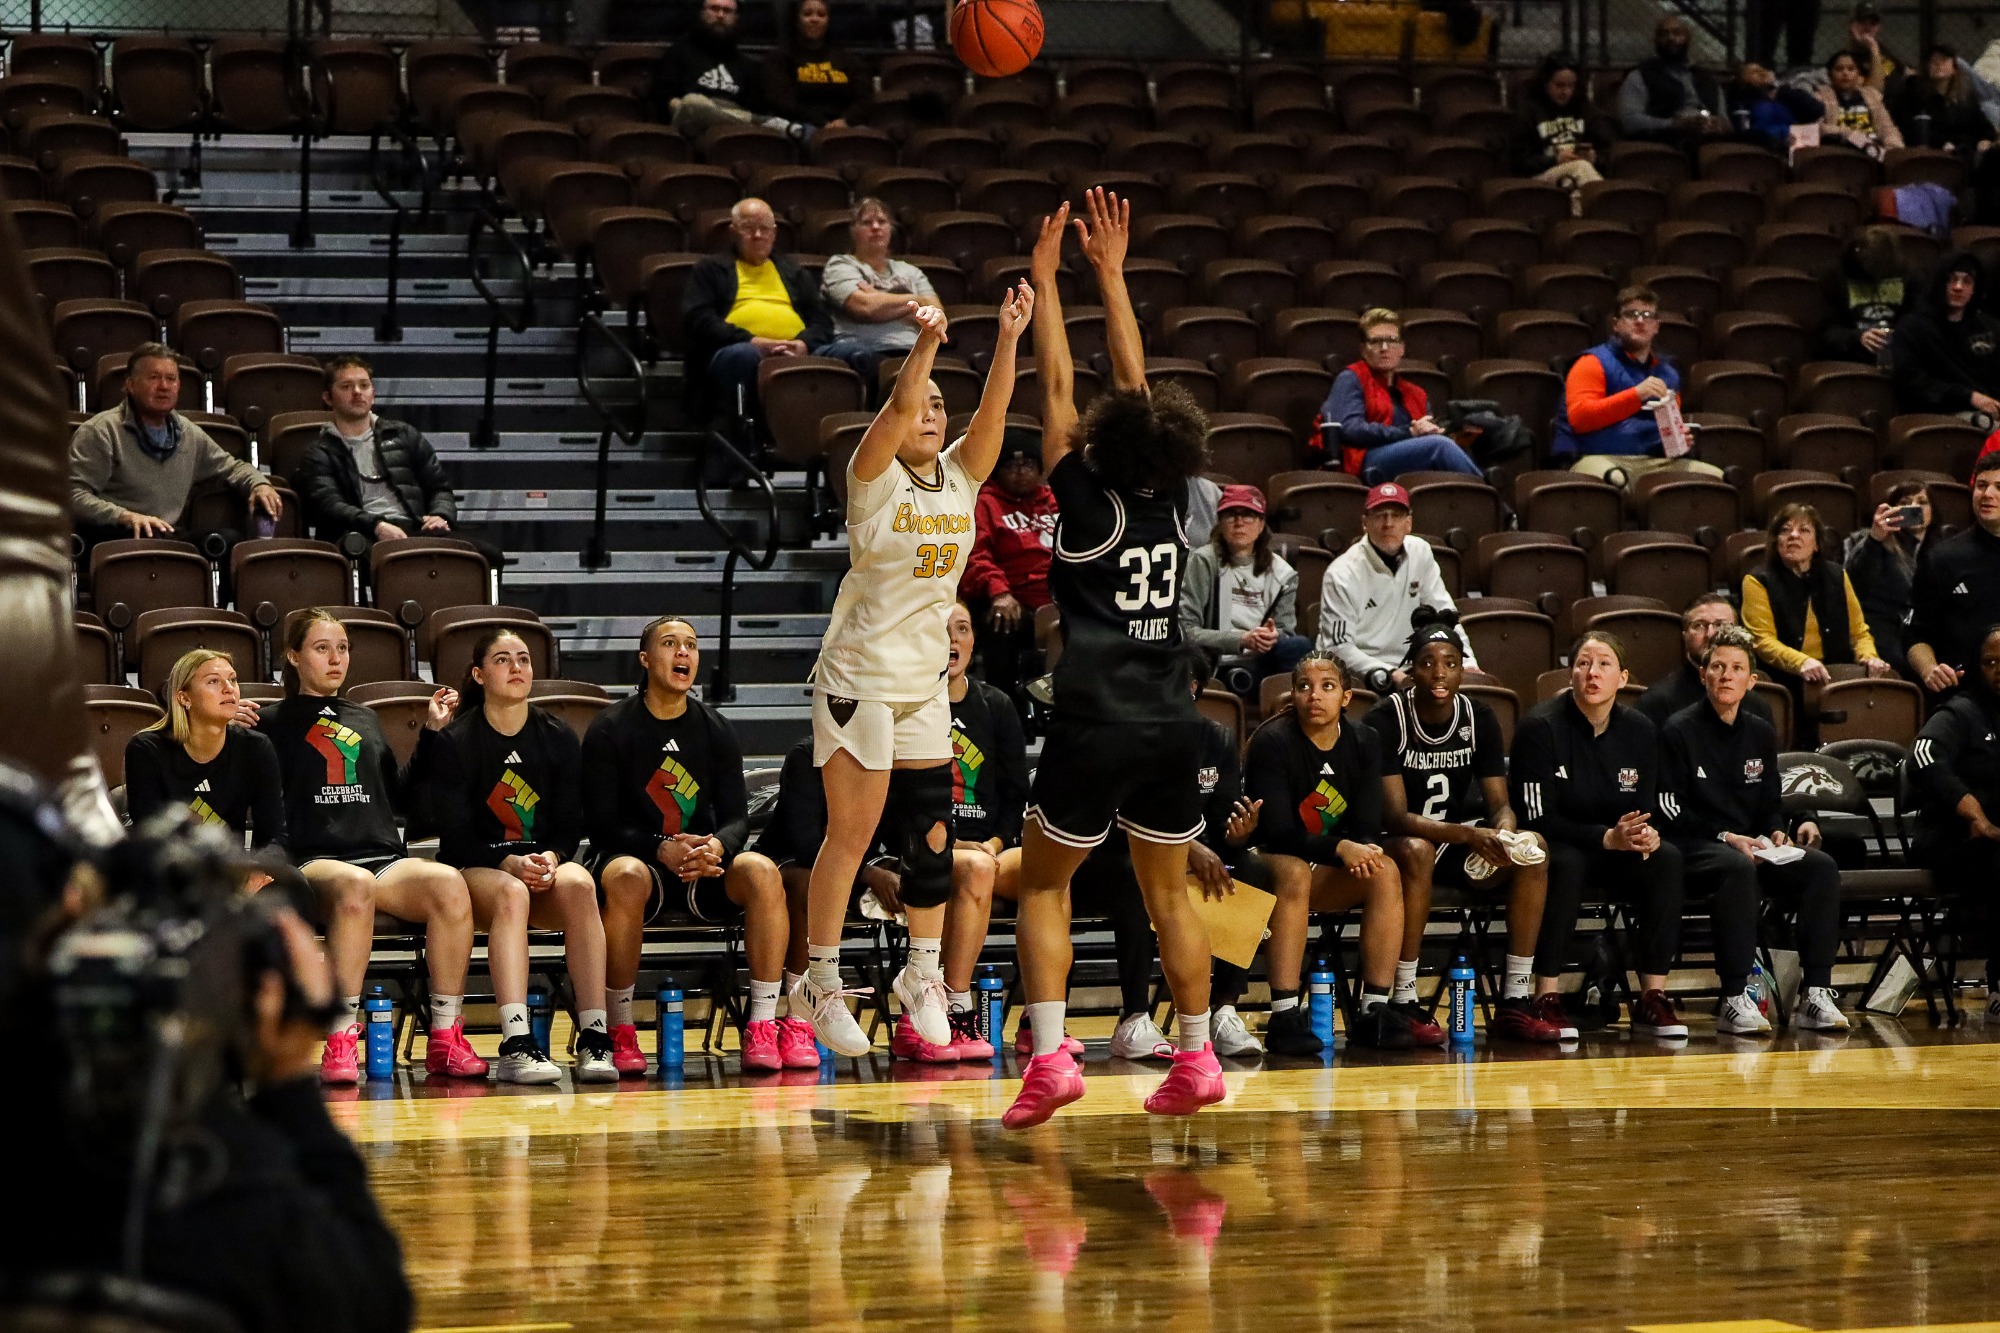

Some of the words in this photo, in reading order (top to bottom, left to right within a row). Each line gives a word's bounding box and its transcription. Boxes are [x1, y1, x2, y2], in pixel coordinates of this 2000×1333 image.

[913, 543, 959, 578] 33
[1114, 542, 1178, 611] 33
[1128, 617, 1169, 641] FRANKS
[1403, 747, 1473, 770] MASCHUSETT
[314, 795, 340, 804] BLACK
[1422, 773, 1450, 821] 2
[1456, 981, 1465, 1032] POWERADE
